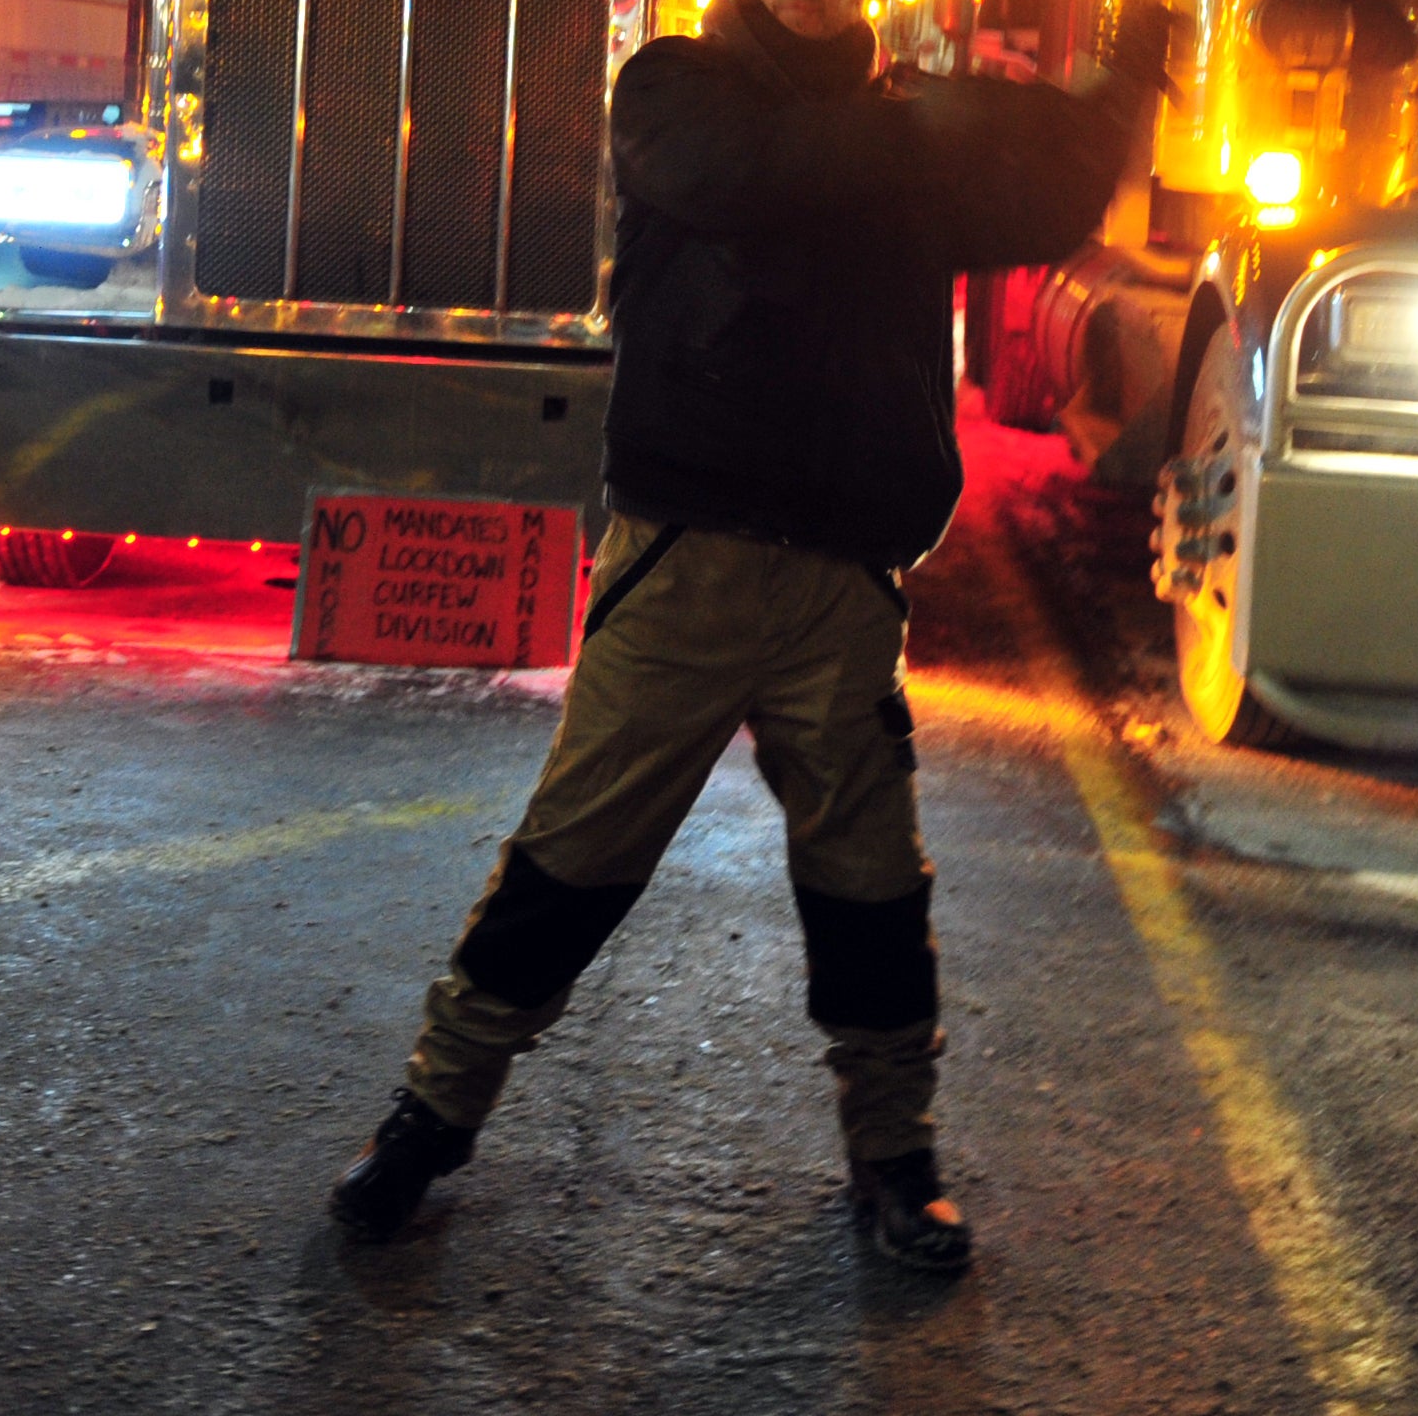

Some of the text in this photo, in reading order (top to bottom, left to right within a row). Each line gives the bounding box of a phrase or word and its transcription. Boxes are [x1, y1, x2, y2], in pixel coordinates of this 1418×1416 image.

[312, 508, 367, 552] NO
[384, 508, 509, 544] MANDATES
[378, 545, 505, 581] LOCKDOWN
[373, 581, 479, 610] CURFEW
[375, 612, 497, 649] DIVISION
